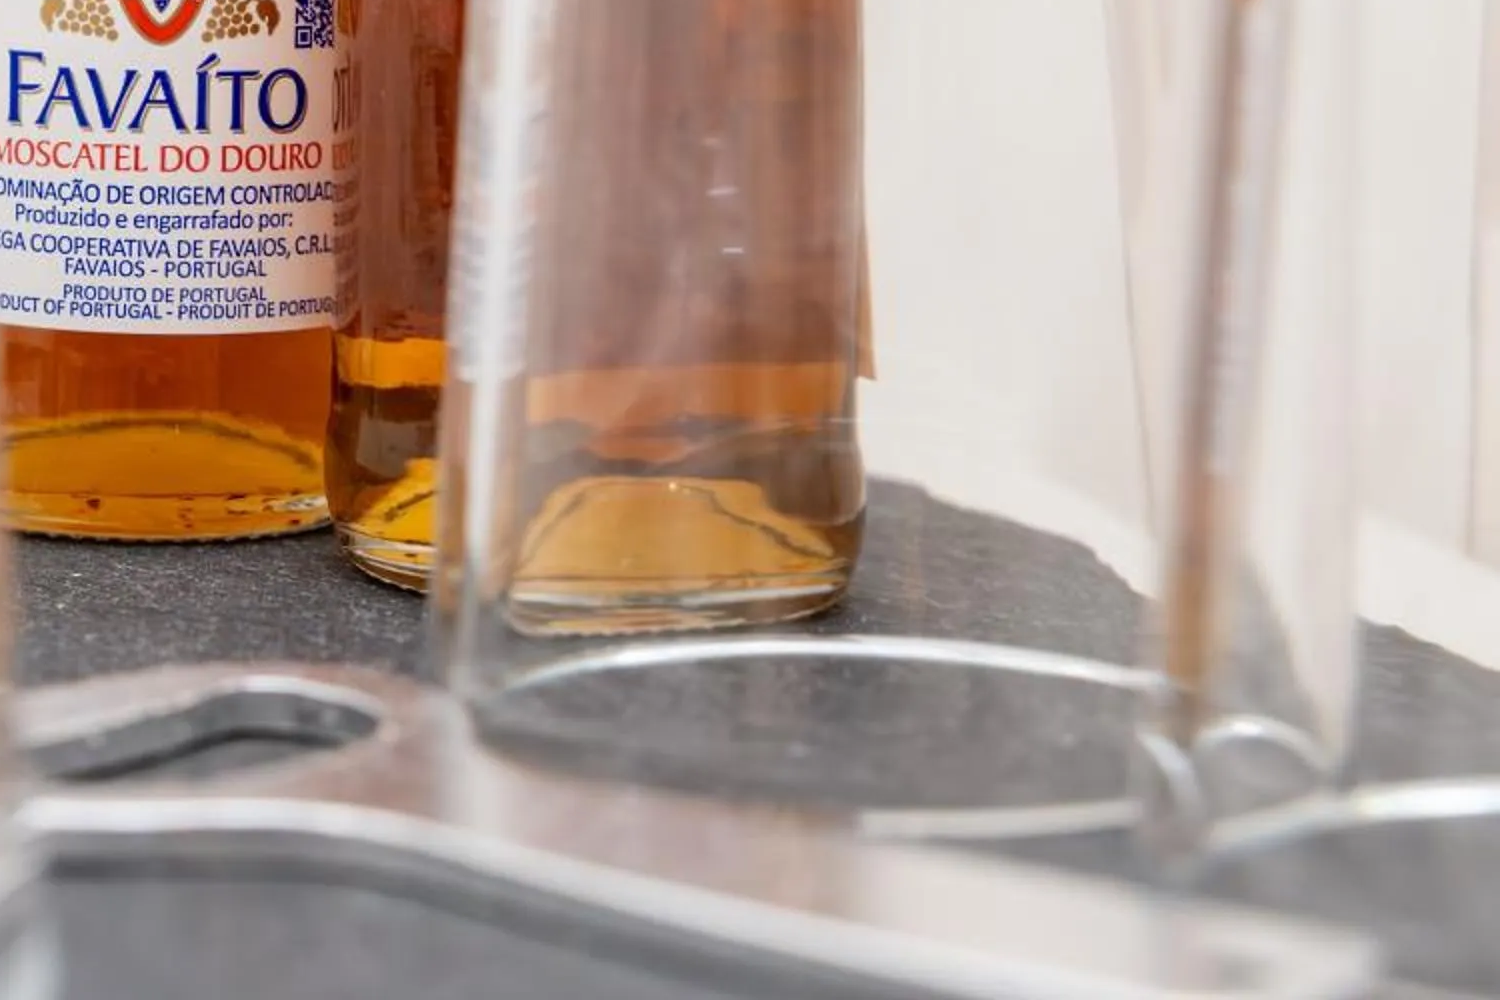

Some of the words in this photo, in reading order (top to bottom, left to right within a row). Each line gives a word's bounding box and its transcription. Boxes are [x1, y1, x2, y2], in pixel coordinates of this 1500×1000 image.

[7, 48, 309, 134] FAVAÍTO
[159, 144, 210, 173] DO
[220, 141, 323, 173] DOURO
[107, 185, 134, 205] DE
[139, 185, 225, 206] ORIGEM
[231, 181, 334, 205] CONTROLAD
[15, 203, 110, 229] Produzido
[115, 213, 128, 228] e
[133, 209, 254, 234] engarrafado
[258, 212, 293, 232] por:
[30, 233, 171, 259] COOPERATIVA
[177, 240, 203, 258] DE
[209, 237, 291, 259] FAVAIOS,
[65, 257, 146, 278] FAVAIOS
[164, 259, 267, 279] PORTUGAL
[63, 283, 147, 303] PRODUTO
[152, 287, 174, 303] DE
[179, 286, 267, 303] PORTUGAL
[43, 299, 65, 315] OF
[70, 301, 162, 320] PORTUGAL
[177, 303, 252, 320] PRODUIT
[255, 302, 275, 318] DE
